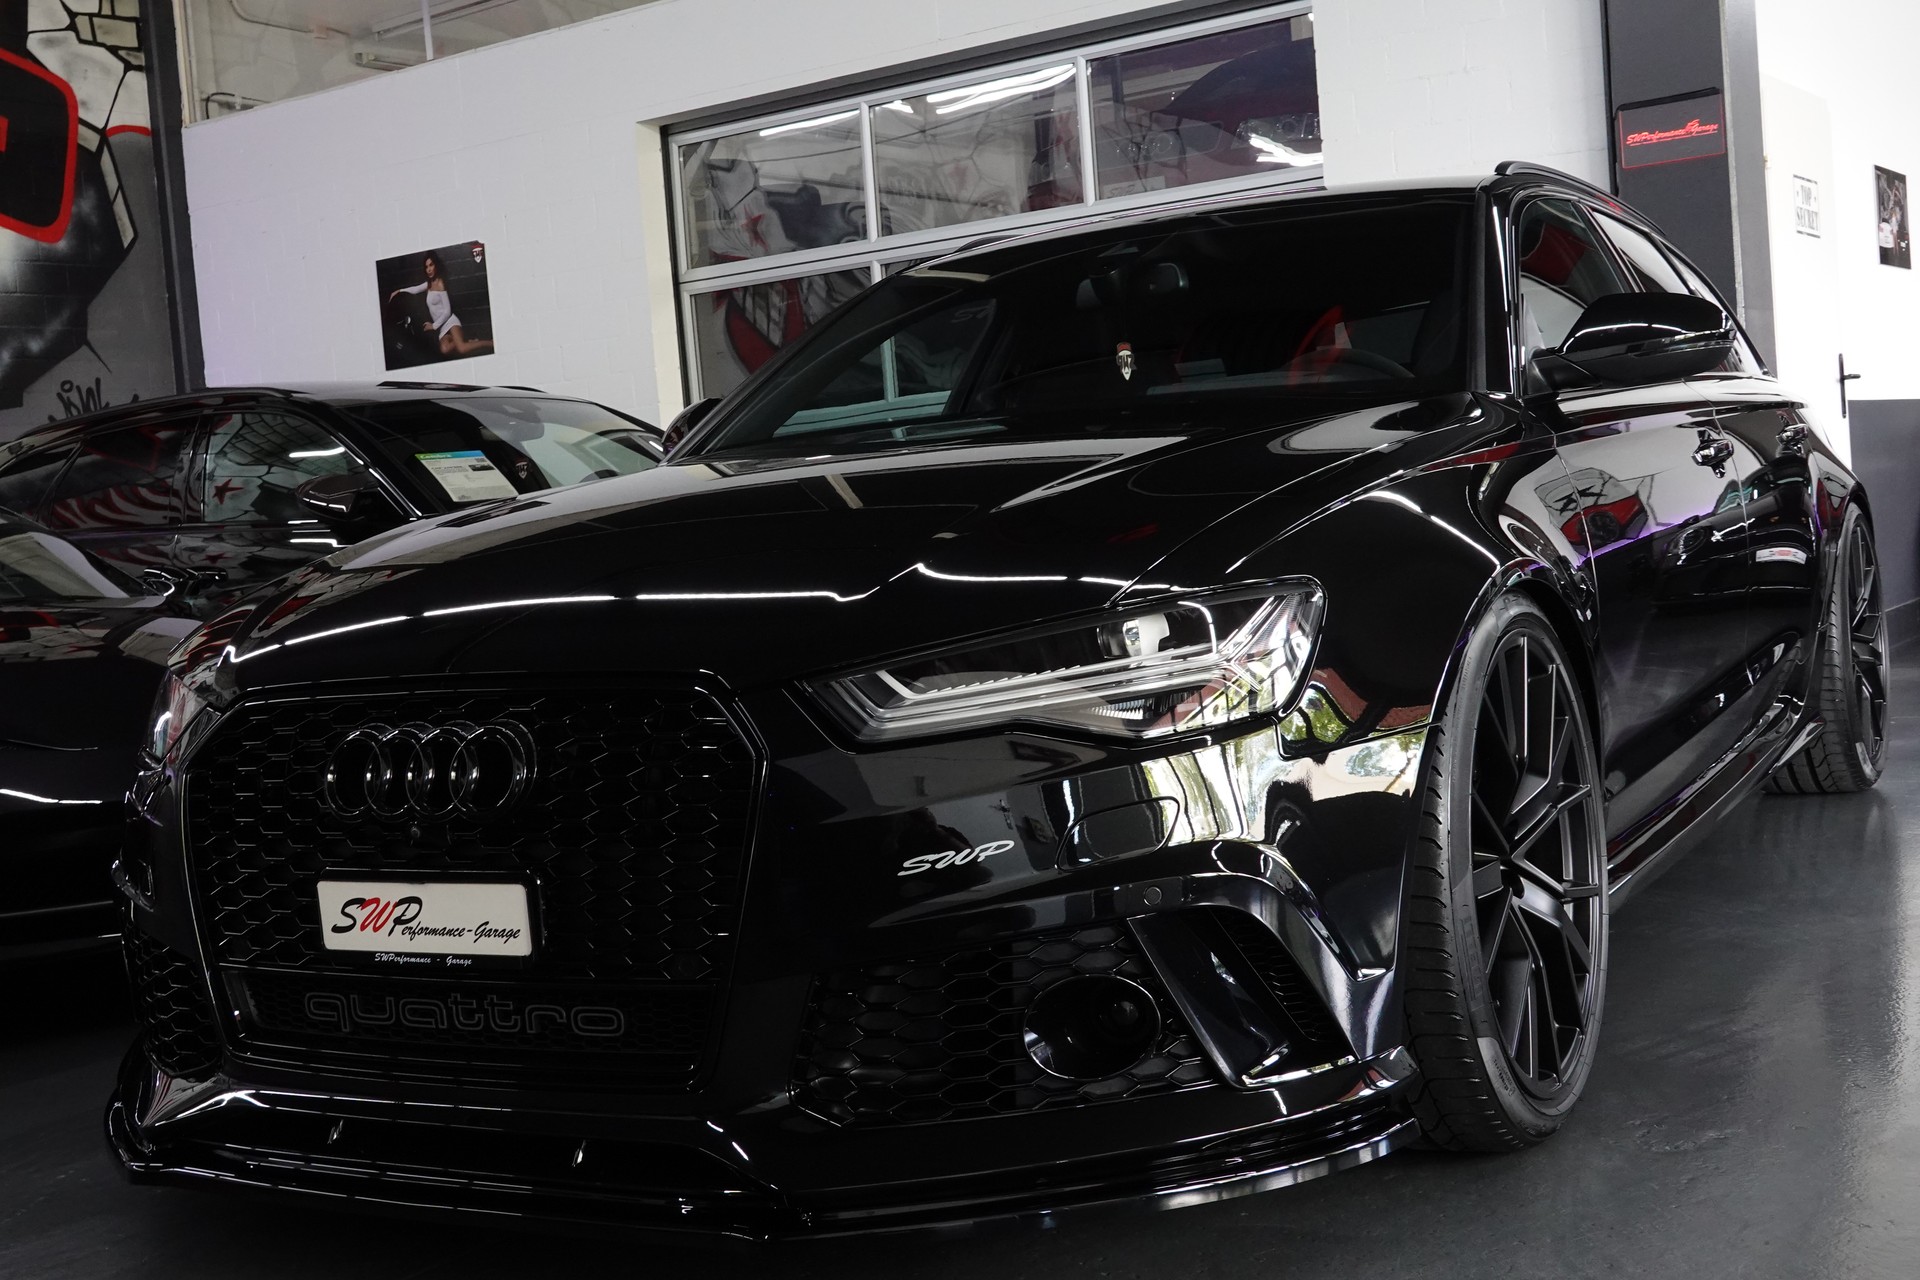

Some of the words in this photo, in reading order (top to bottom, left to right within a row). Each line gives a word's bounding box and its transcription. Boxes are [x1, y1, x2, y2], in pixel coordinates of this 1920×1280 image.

[1800, 184, 1812, 207] TOP
[1796, 206, 1819, 231] SECRET
[897, 840, 1015, 876] SWP
[374, 952, 432, 964] SWPerformance
[446, 955, 473, 967] Garage
[304, 991, 625, 1037] quattro
